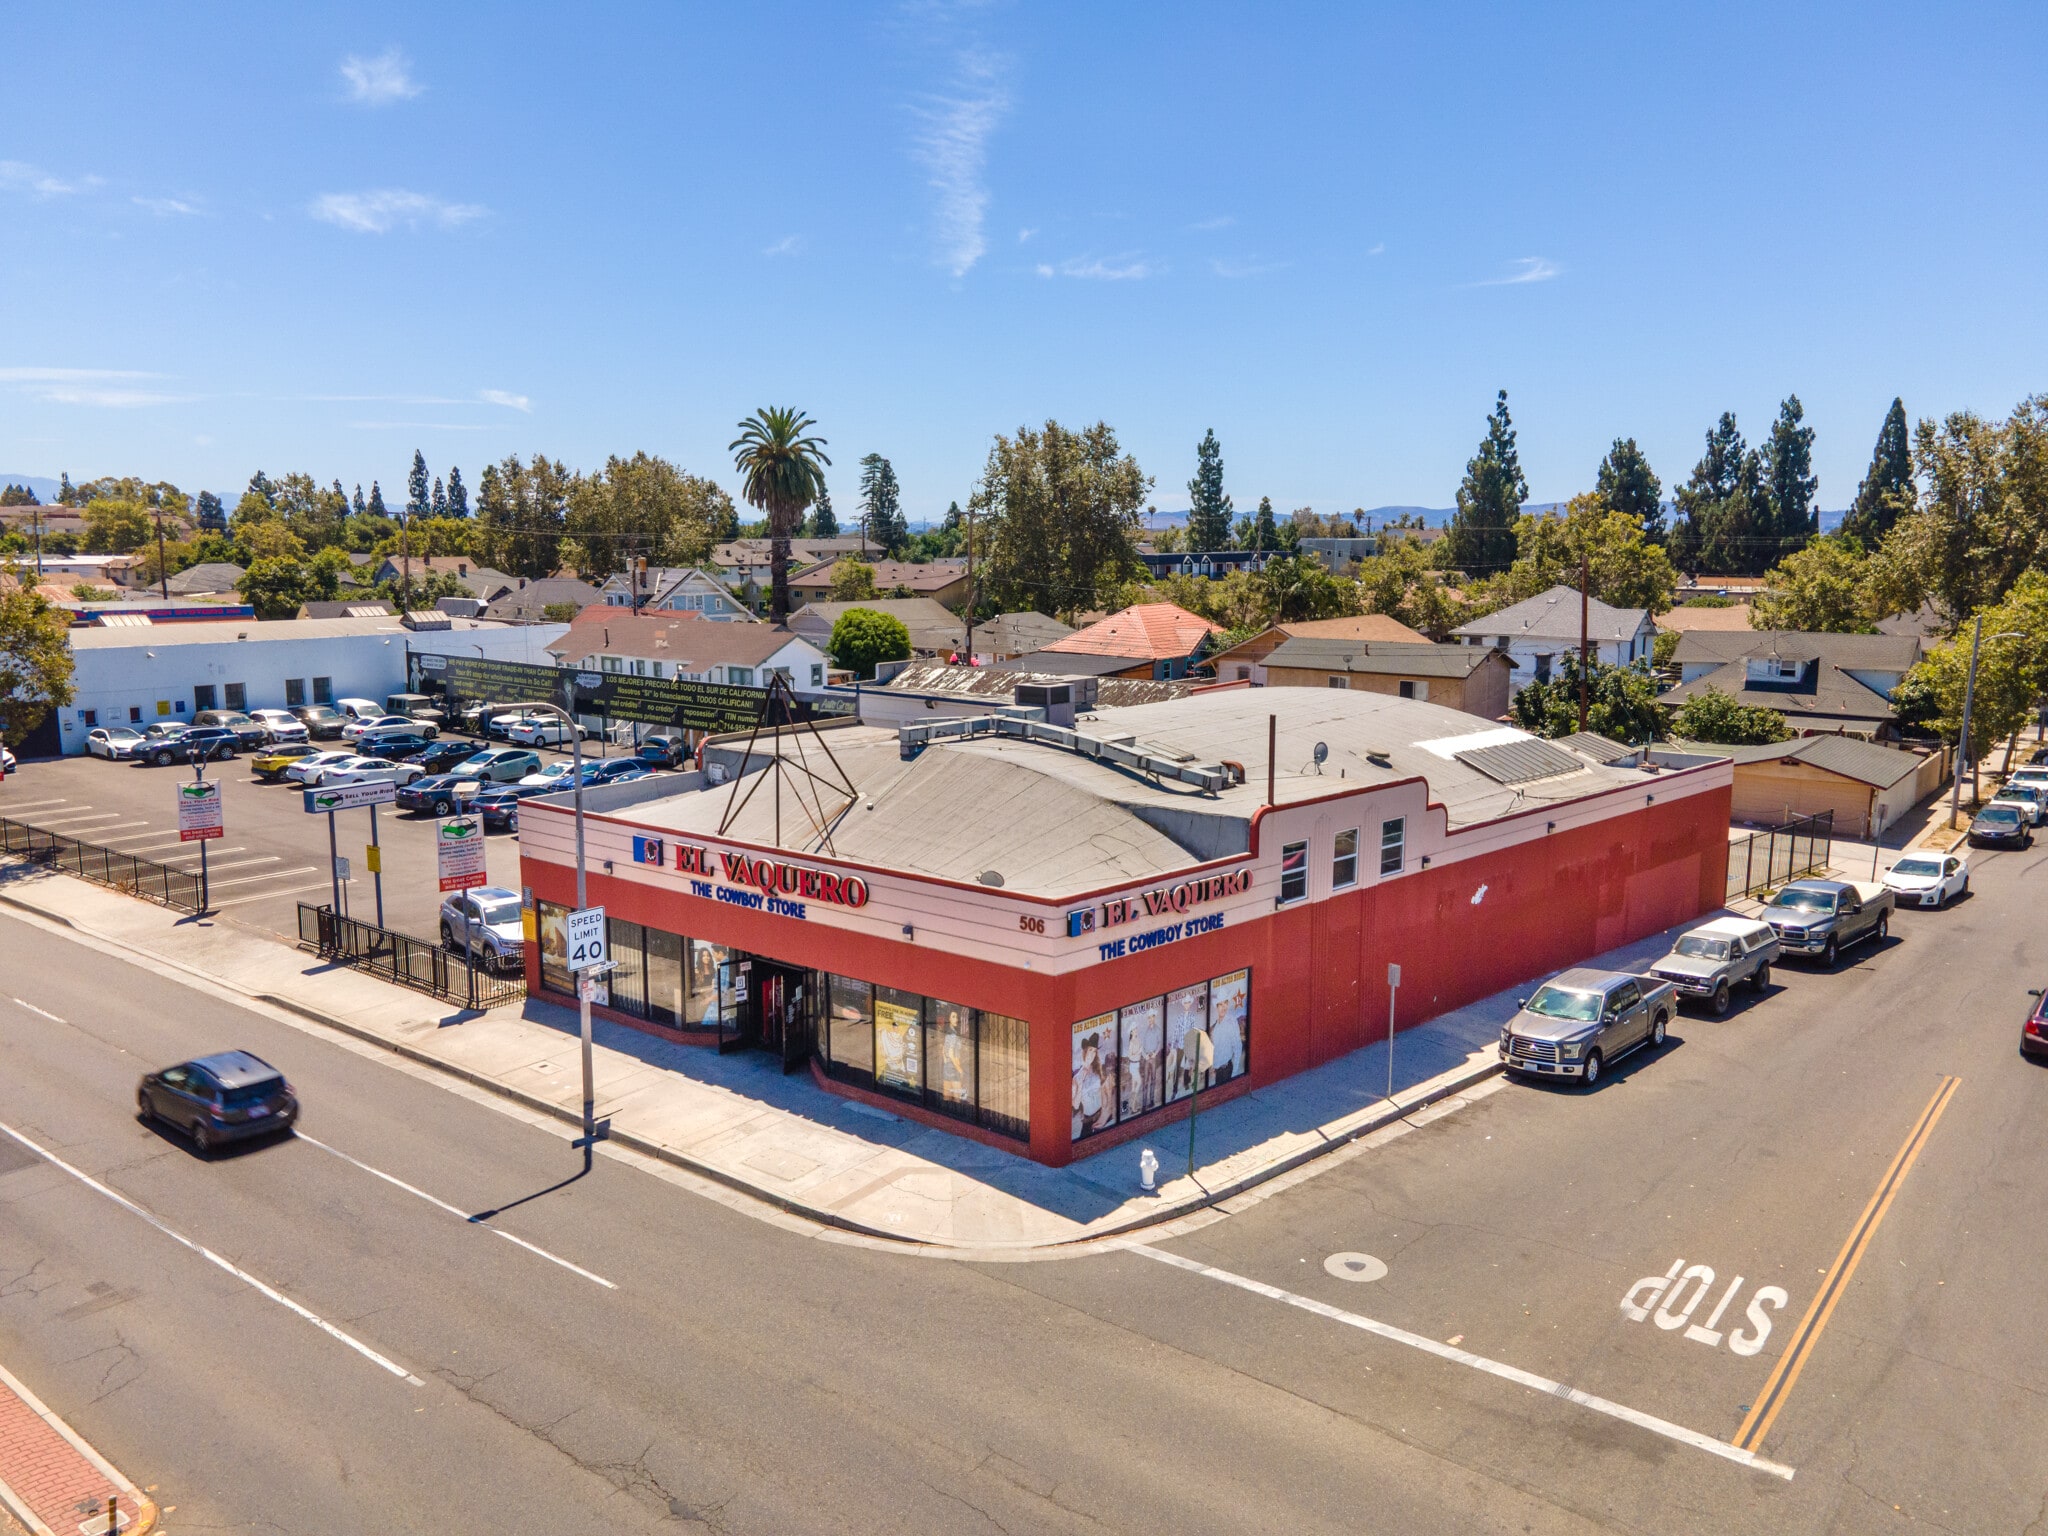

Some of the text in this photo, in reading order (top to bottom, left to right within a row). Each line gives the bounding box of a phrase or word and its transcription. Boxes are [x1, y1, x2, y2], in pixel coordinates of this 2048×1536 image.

[618, 677, 644, 687] MEJORES
[645, 680, 669, 689] PRECIOS
[671, 682, 679, 690] DE
[680, 684, 696, 692] TODO
[706, 687, 718, 695] SUR
[729, 689, 766, 699] CALIFORNIA
[618, 687, 640, 696] Nosotros
[697, 695, 717, 705] TODOS
[674, 842, 869, 909] EL VAQUERO
[690, 880, 806, 919] THE COWBOY STORE
[1103, 868, 1254, 928] EL VAQUERO
[571, 914, 602, 928] SPEED
[1019, 916, 1045, 934] 506
[574, 928, 598, 940] LIMIT
[1099, 913, 1225, 961] THE COWBOY STORE
[572, 941, 602, 961] 40
[878, 1010, 893, 1020] FREE
[1620, 1258, 1788, 1356] STOP
